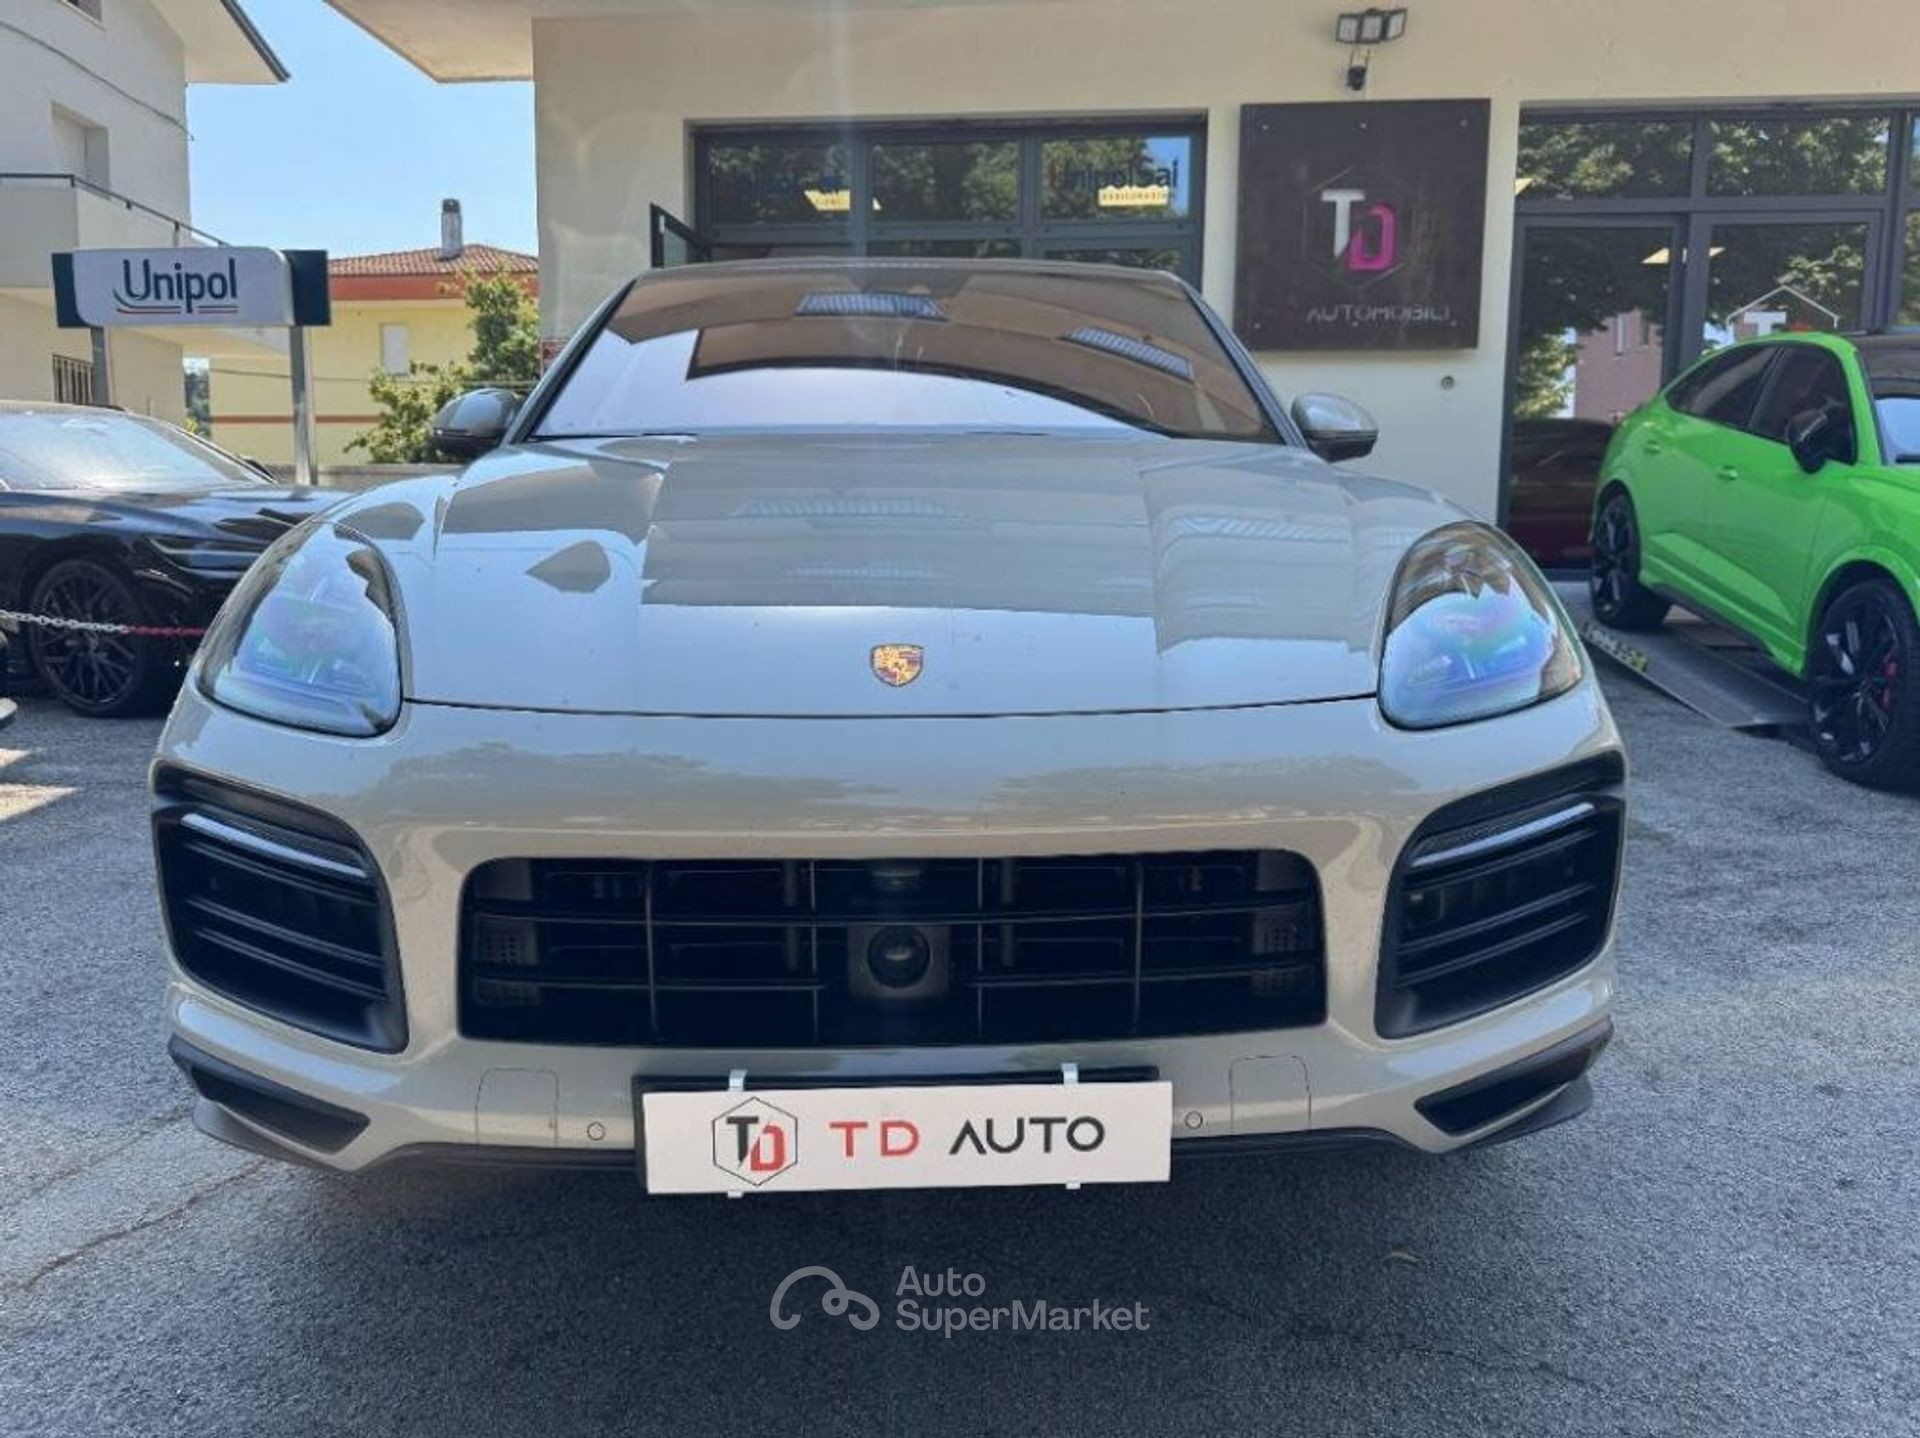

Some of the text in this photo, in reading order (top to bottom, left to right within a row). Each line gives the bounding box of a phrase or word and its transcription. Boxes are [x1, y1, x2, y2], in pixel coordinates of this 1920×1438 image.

[1321, 189, 1397, 271] TD
[121, 257, 238, 313] Unipol
[726, 1115, 786, 1172] TD
[829, 1116, 1106, 1158] TD AUTO
